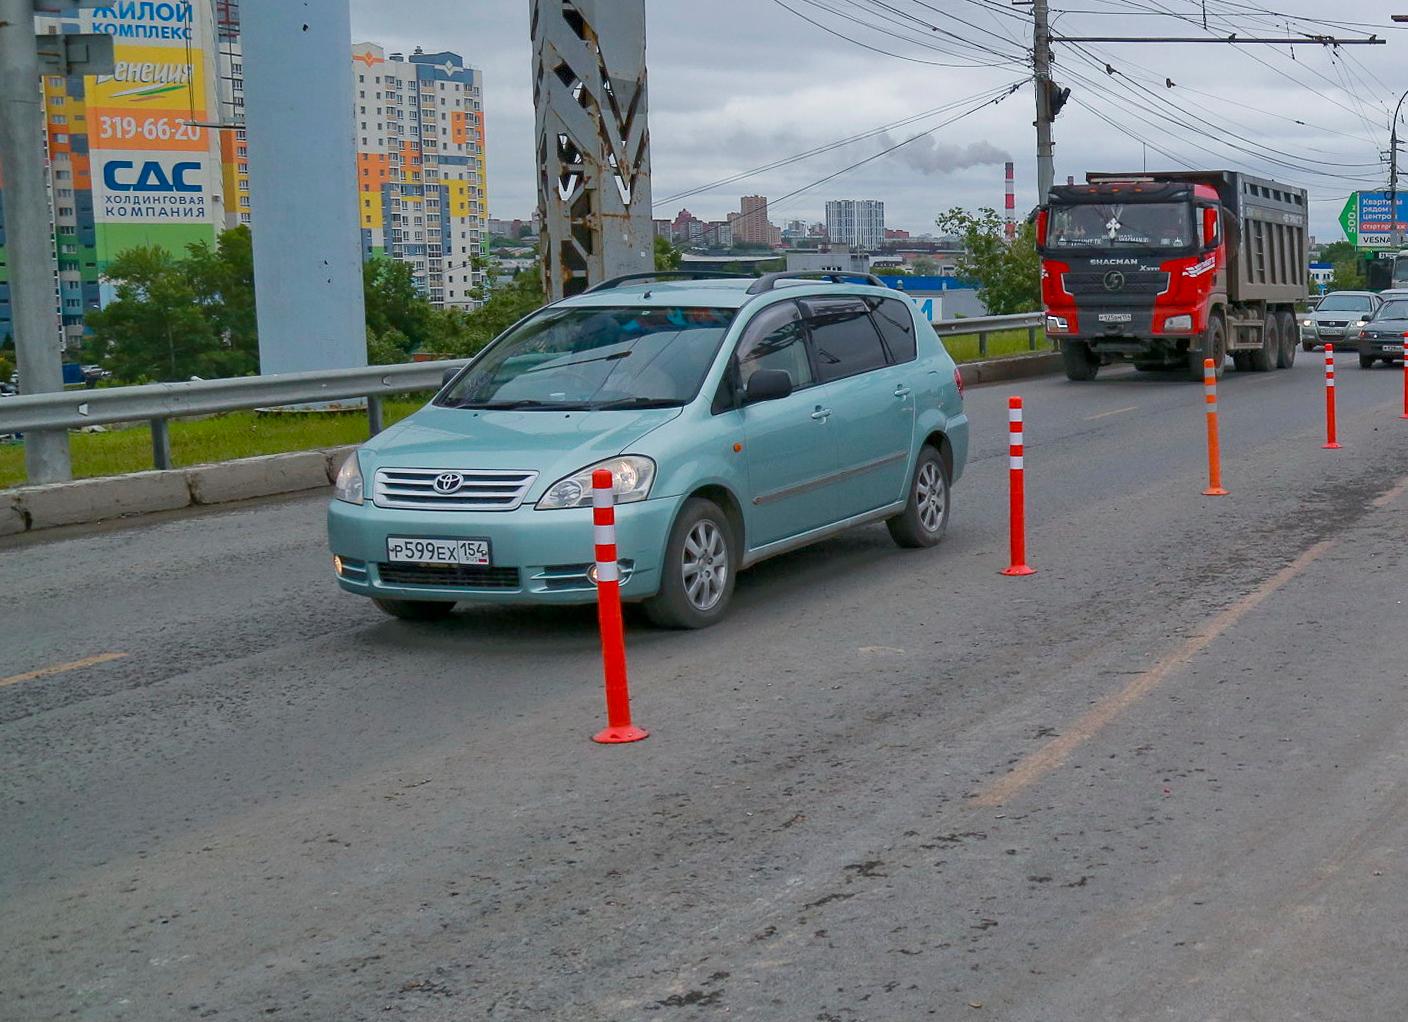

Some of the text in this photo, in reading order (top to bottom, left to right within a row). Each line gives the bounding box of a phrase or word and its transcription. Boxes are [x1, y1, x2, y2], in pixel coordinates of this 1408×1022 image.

[92, 22, 192, 40] КОМПЛЕКС
[96, 61, 195, 84] енеция
[100, 116, 201, 141] 319-66-20
[103, 160, 203, 193] СДС
[105, 195, 205, 206] ХОЛДИНГОВАЯ
[1363, 198, 1402, 206] Квартиы
[105, 206, 205, 218] КОМПАНИЯ
[1347, 213, 1356, 232] 500
[1090, 258, 1138, 266] SHACMAN
